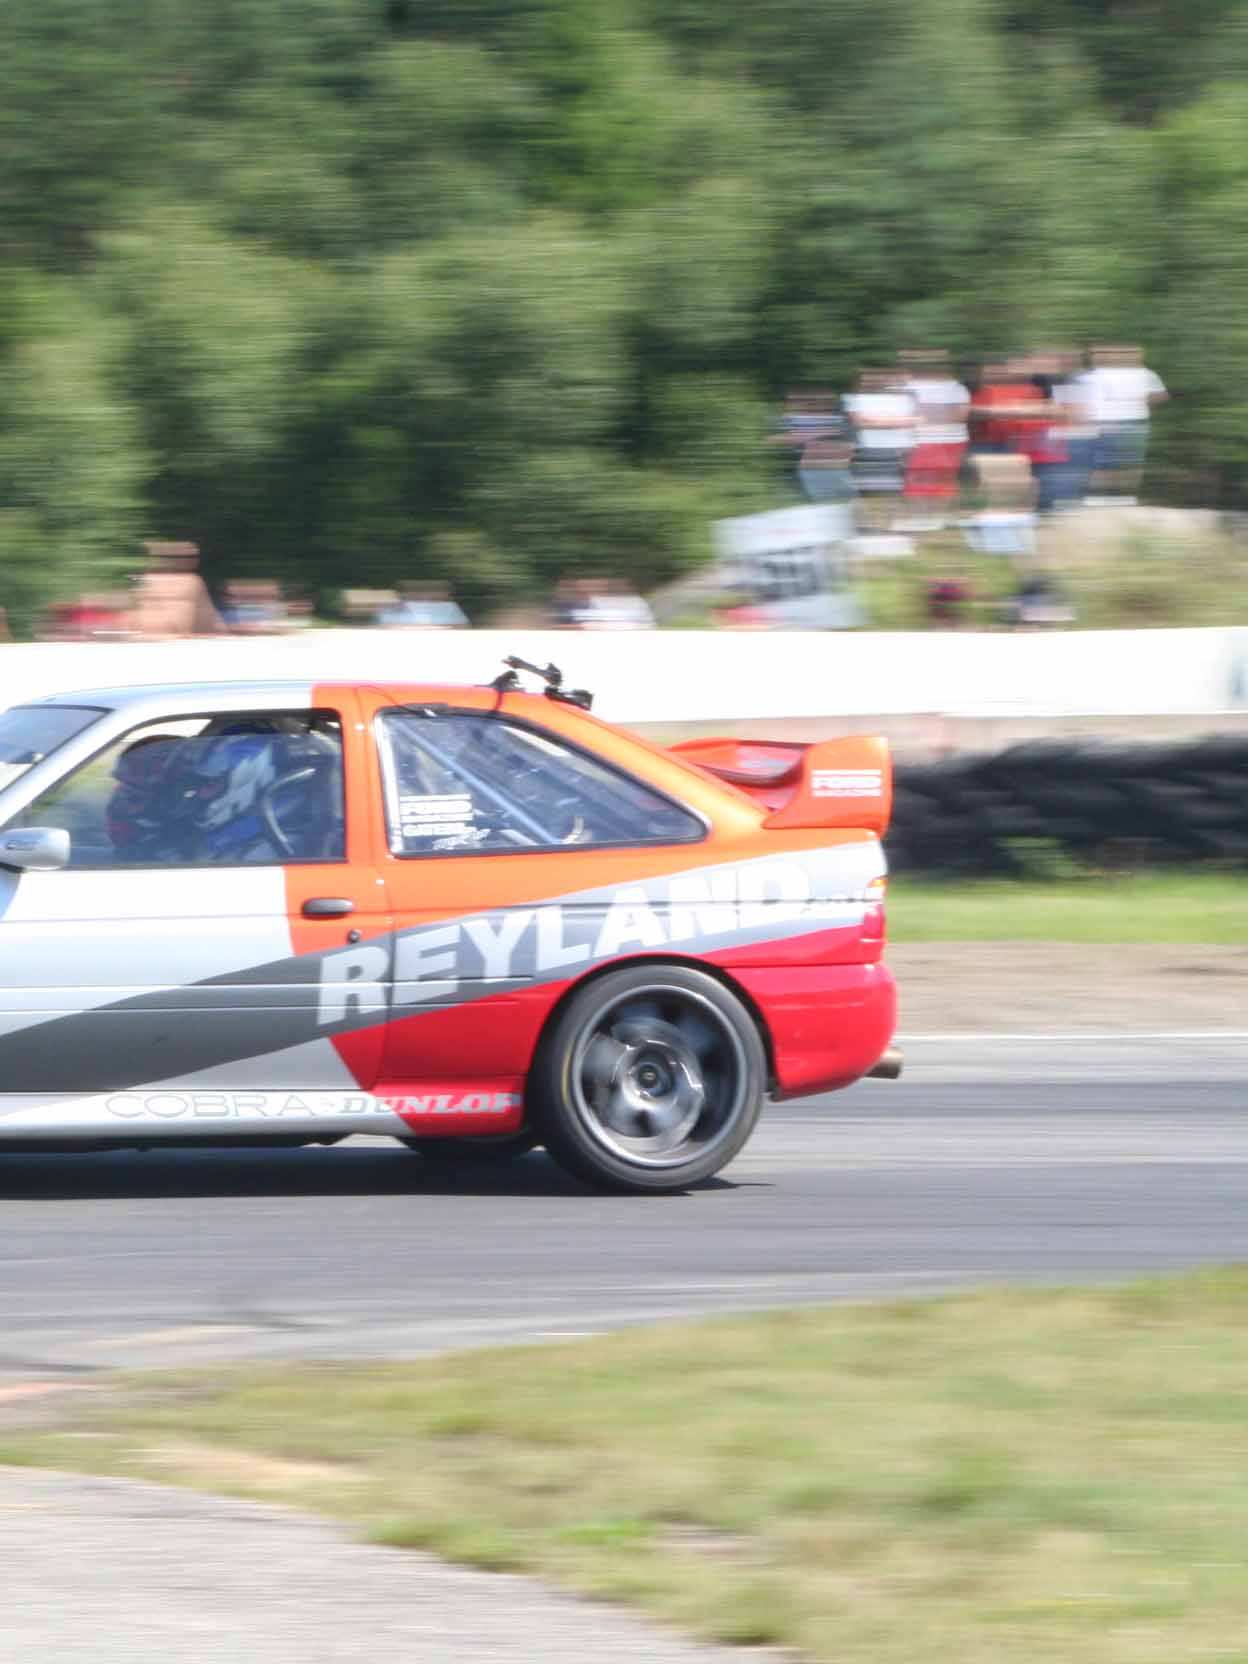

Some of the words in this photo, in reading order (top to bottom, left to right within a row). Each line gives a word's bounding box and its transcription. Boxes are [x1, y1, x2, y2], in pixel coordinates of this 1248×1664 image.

[316, 862, 810, 1026] REYLAND
[104, 1094, 318, 1118] COBRA
[338, 1092, 521, 1114] DUNLOP
